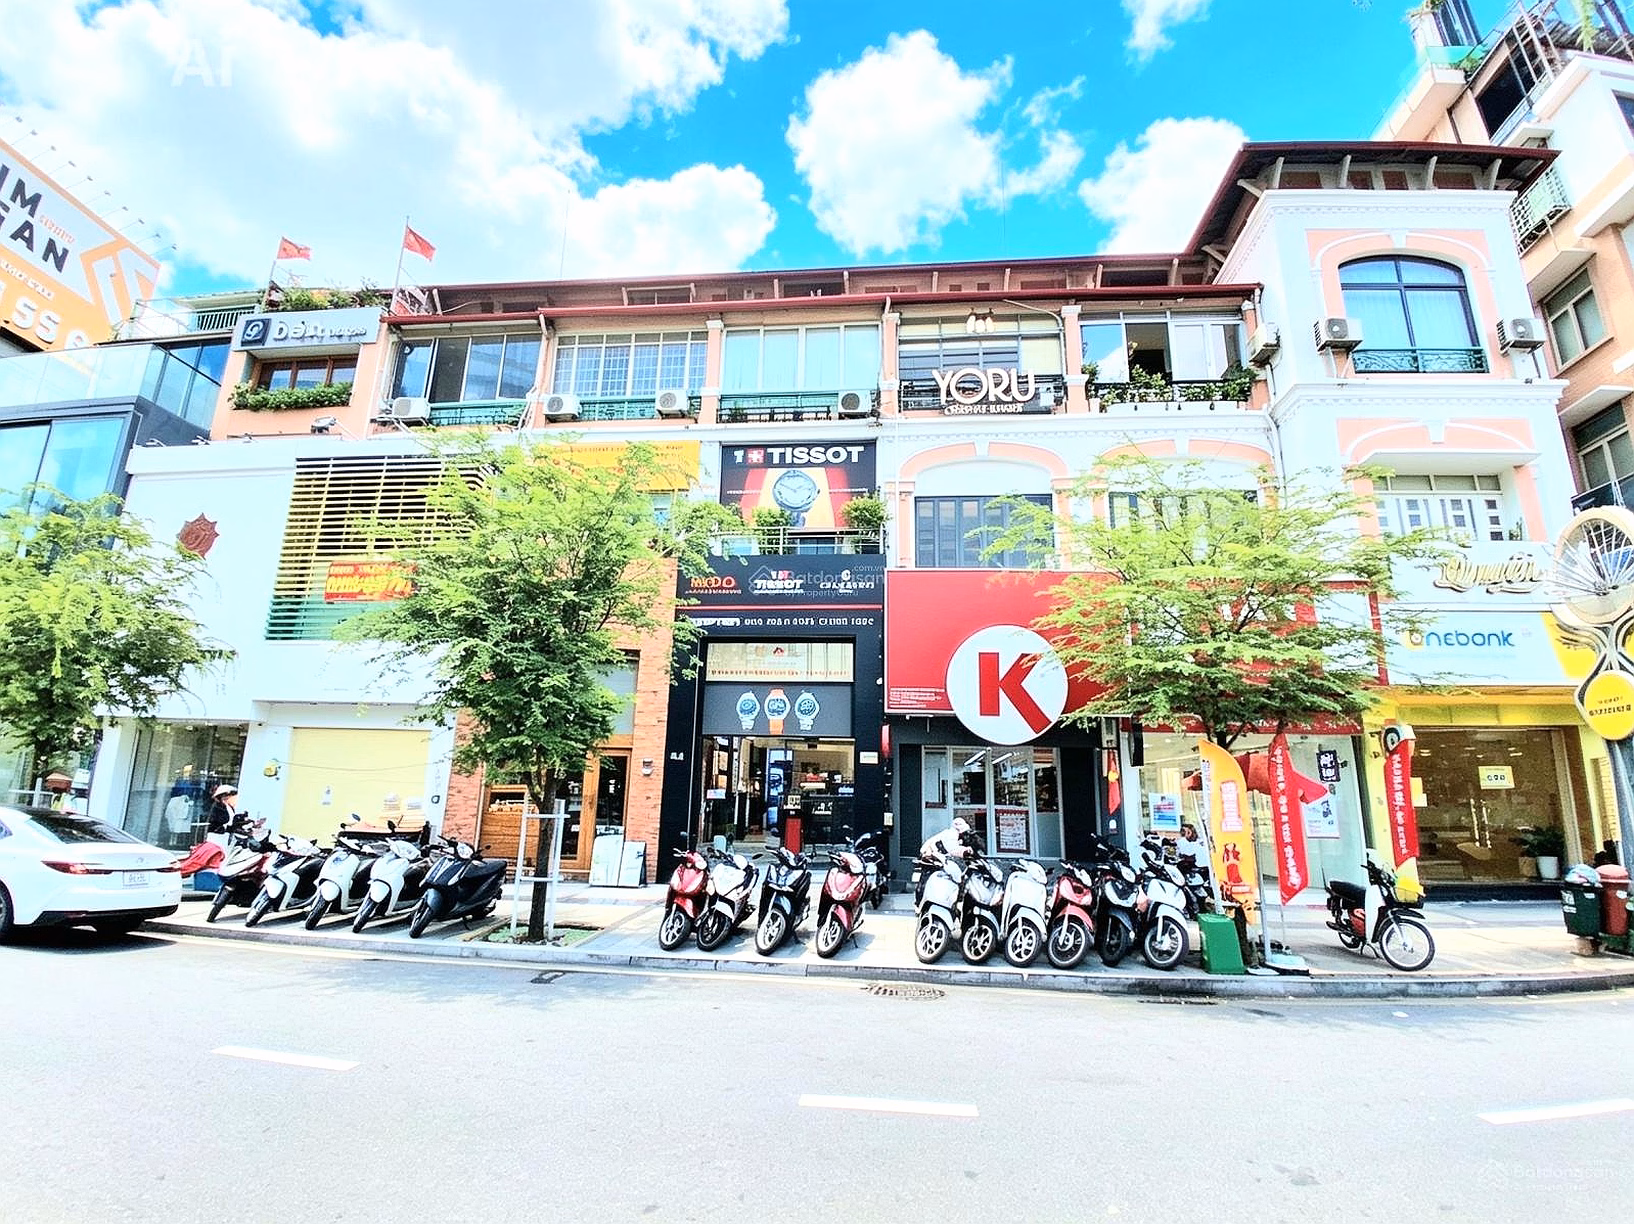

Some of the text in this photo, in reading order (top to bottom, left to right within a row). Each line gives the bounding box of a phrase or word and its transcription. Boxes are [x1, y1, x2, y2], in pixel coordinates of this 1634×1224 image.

[932, 368, 1036, 405] YORU
[767, 446, 865, 464] TISSOT
[978, 652, 1052, 734] K
